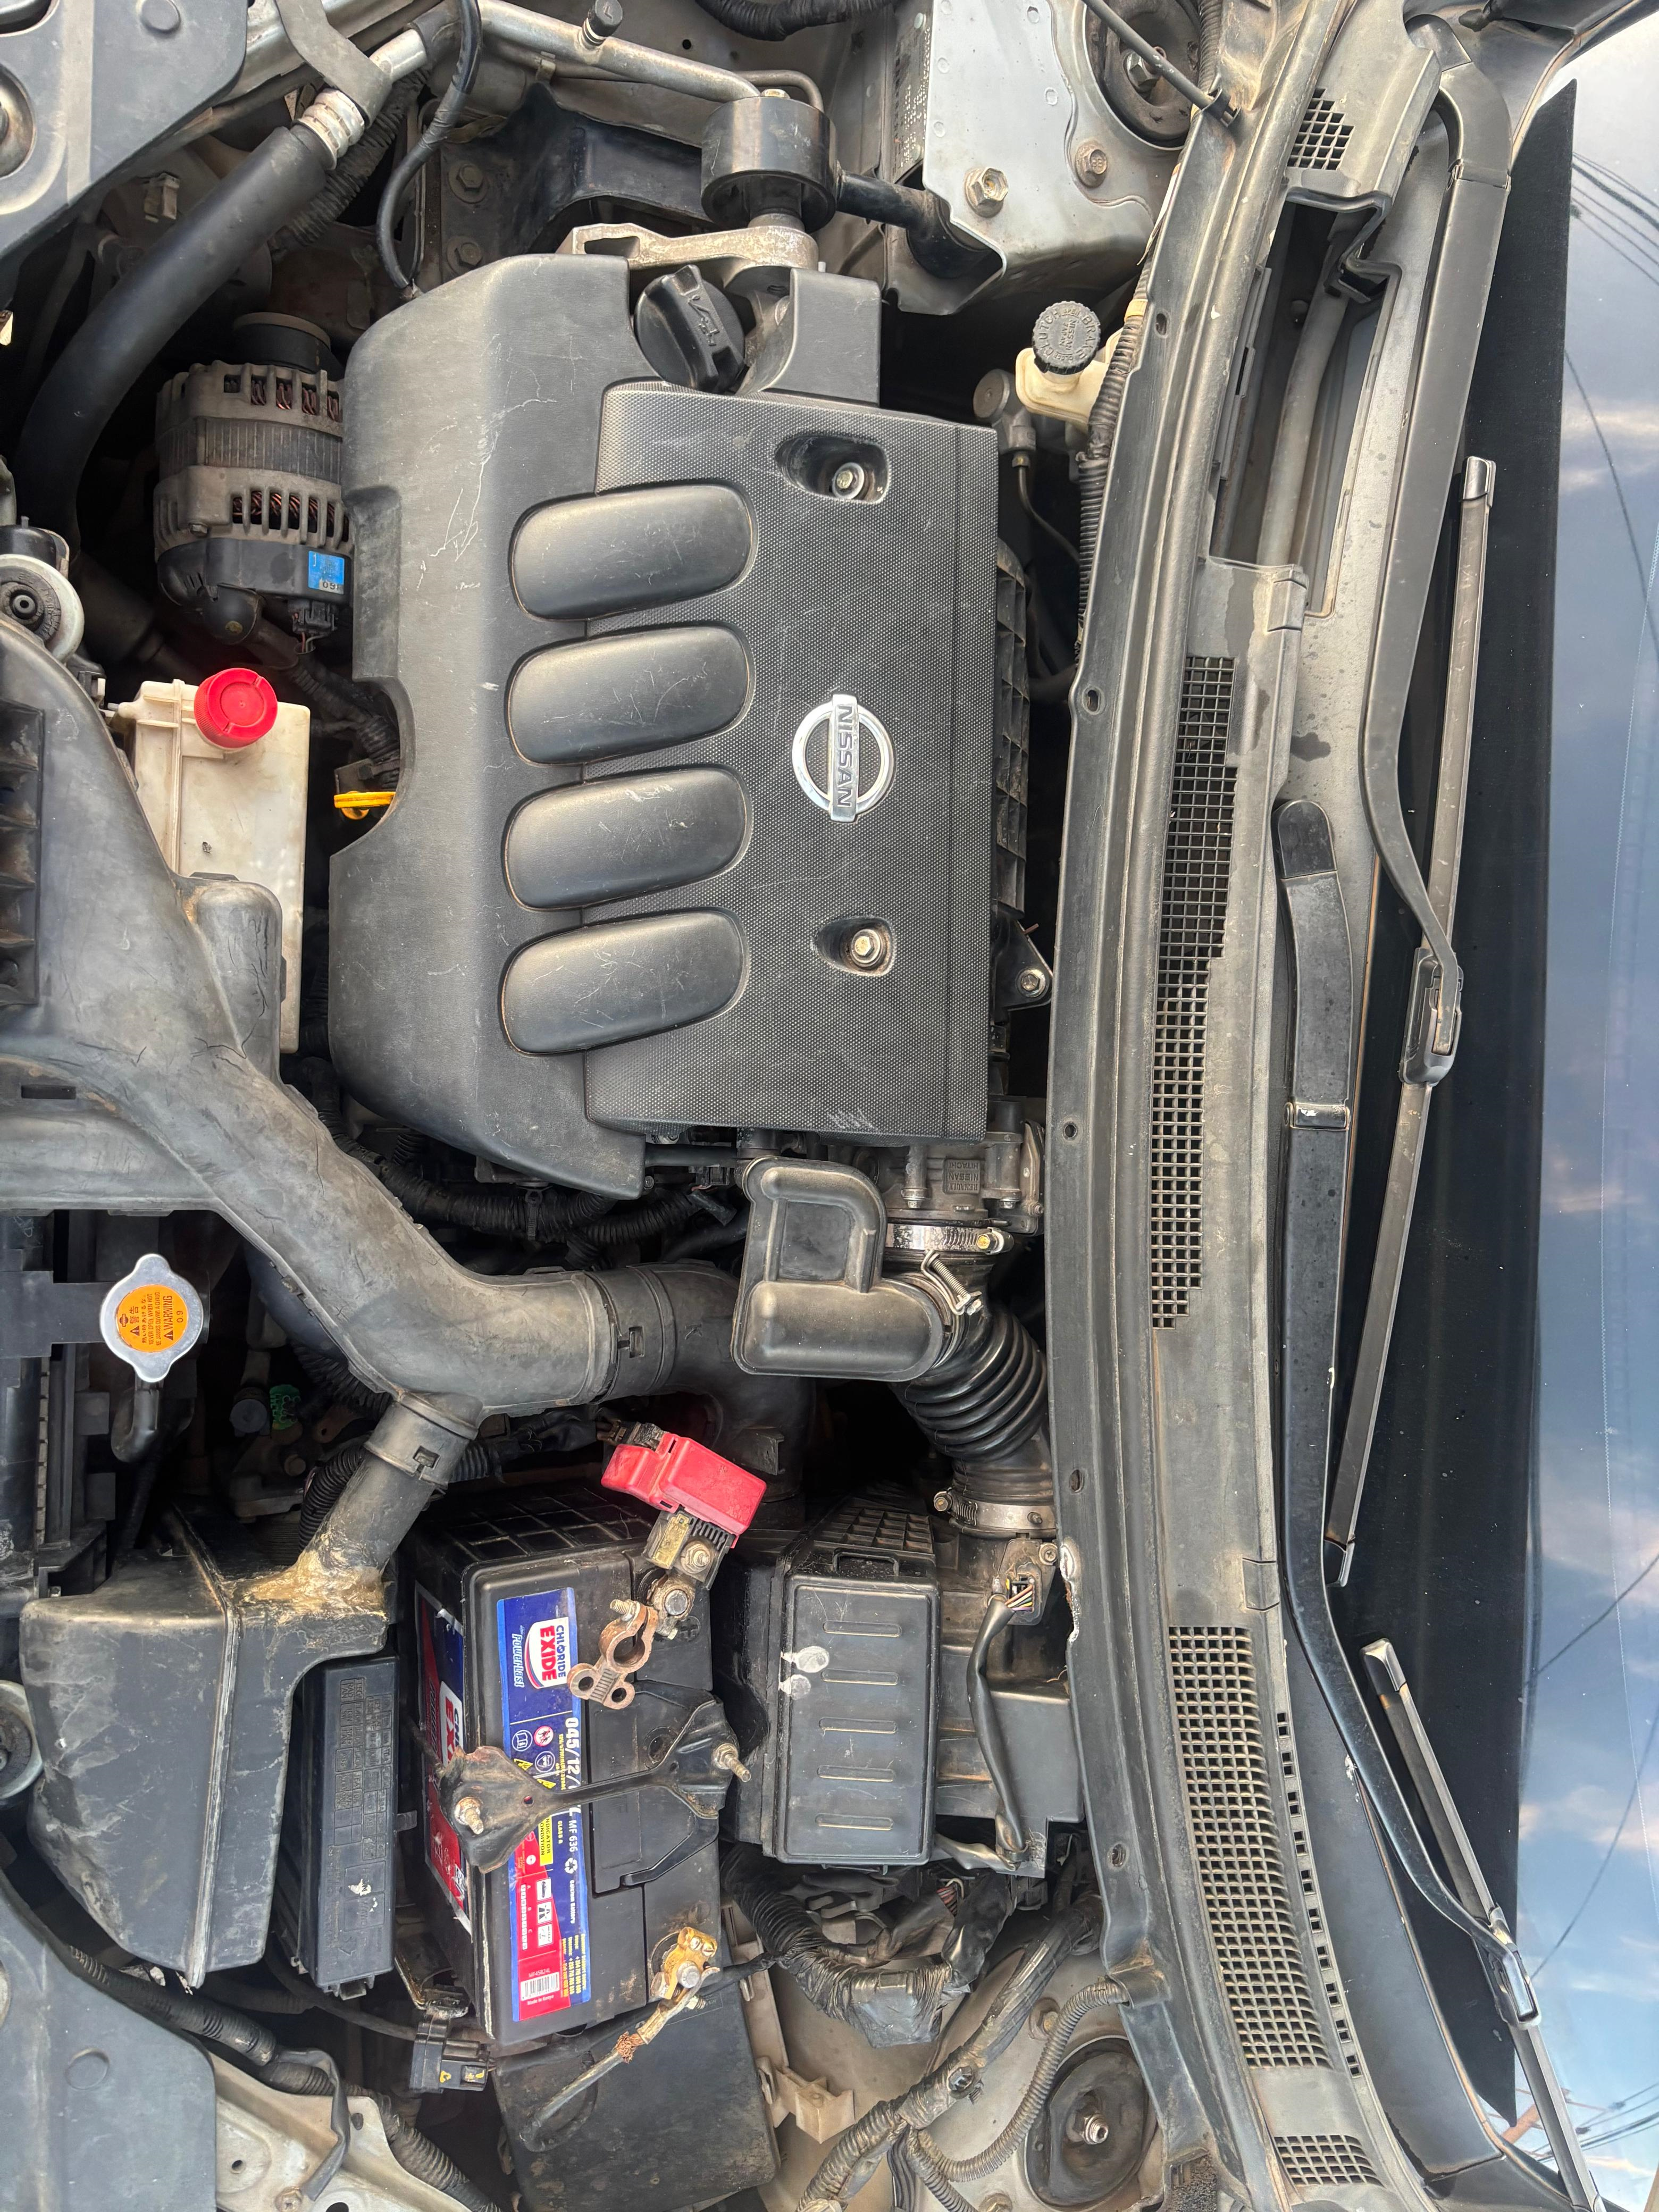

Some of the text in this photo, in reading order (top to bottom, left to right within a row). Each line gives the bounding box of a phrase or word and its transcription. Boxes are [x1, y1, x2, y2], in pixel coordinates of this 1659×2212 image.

[1038, 308, 1061, 359] CLUTCH
[1059, 323, 1069, 346] JAPAN
[1065, 320, 1076, 351] NISSAN
[1075, 315, 1096, 360] BRAKE
[836, 704, 854, 808] NISSAN
[949, 1172, 978, 1181] NISSAN
[163, 1296, 173, 1330] WARNING
[540, 1626, 557, 1681] EXIDE
[556, 1625, 567, 1678] CHLORIDE
[568, 1820, 577, 1833] MF
[569, 1836, 578, 1853] 636
